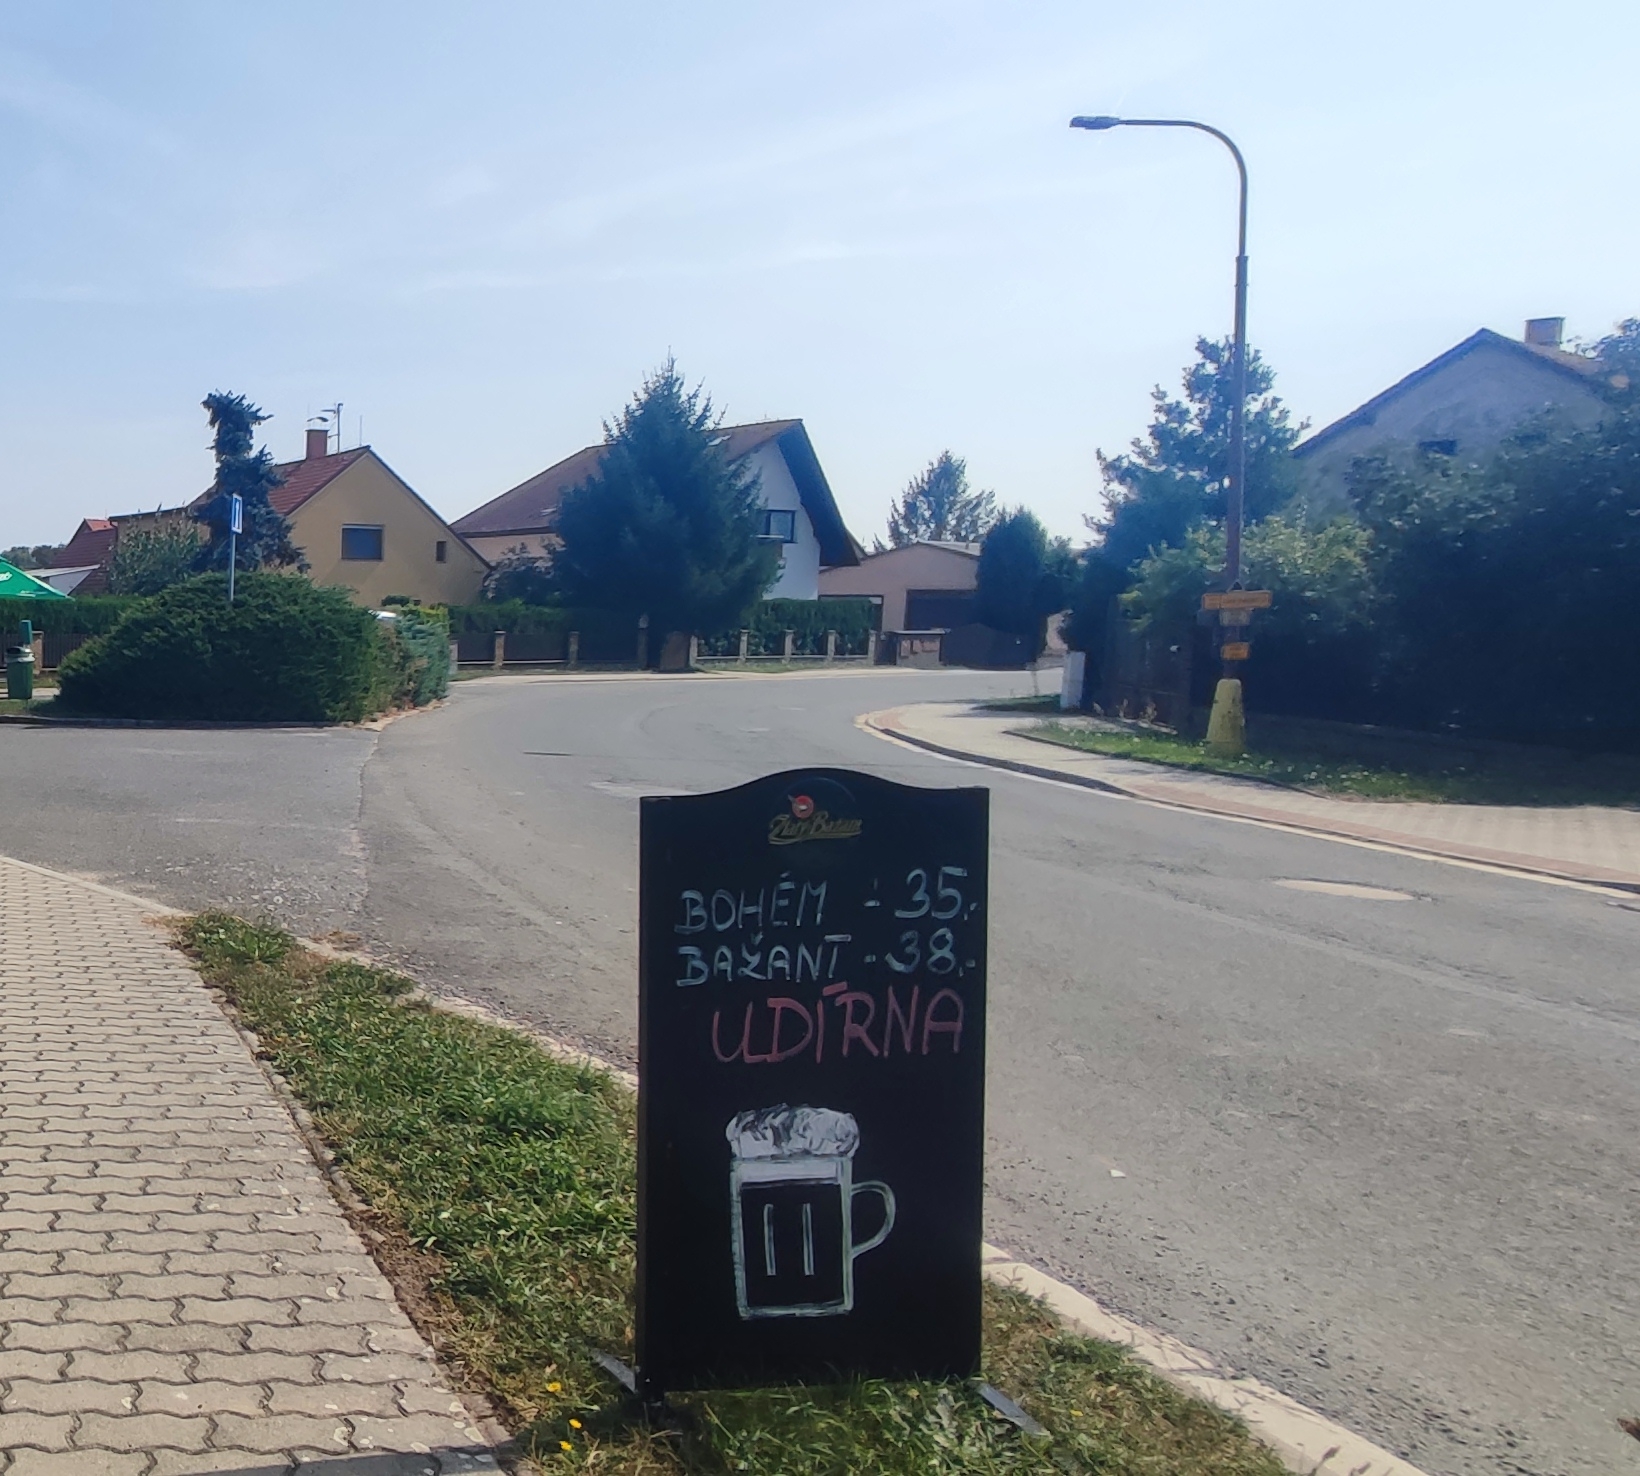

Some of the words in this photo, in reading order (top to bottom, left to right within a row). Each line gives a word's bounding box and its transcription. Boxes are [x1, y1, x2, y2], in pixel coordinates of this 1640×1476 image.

[674, 871, 827, 934] BOHÉM
[676, 931, 852, 987] BAŽANT
[712, 981, 965, 1064] UDÍRNA
